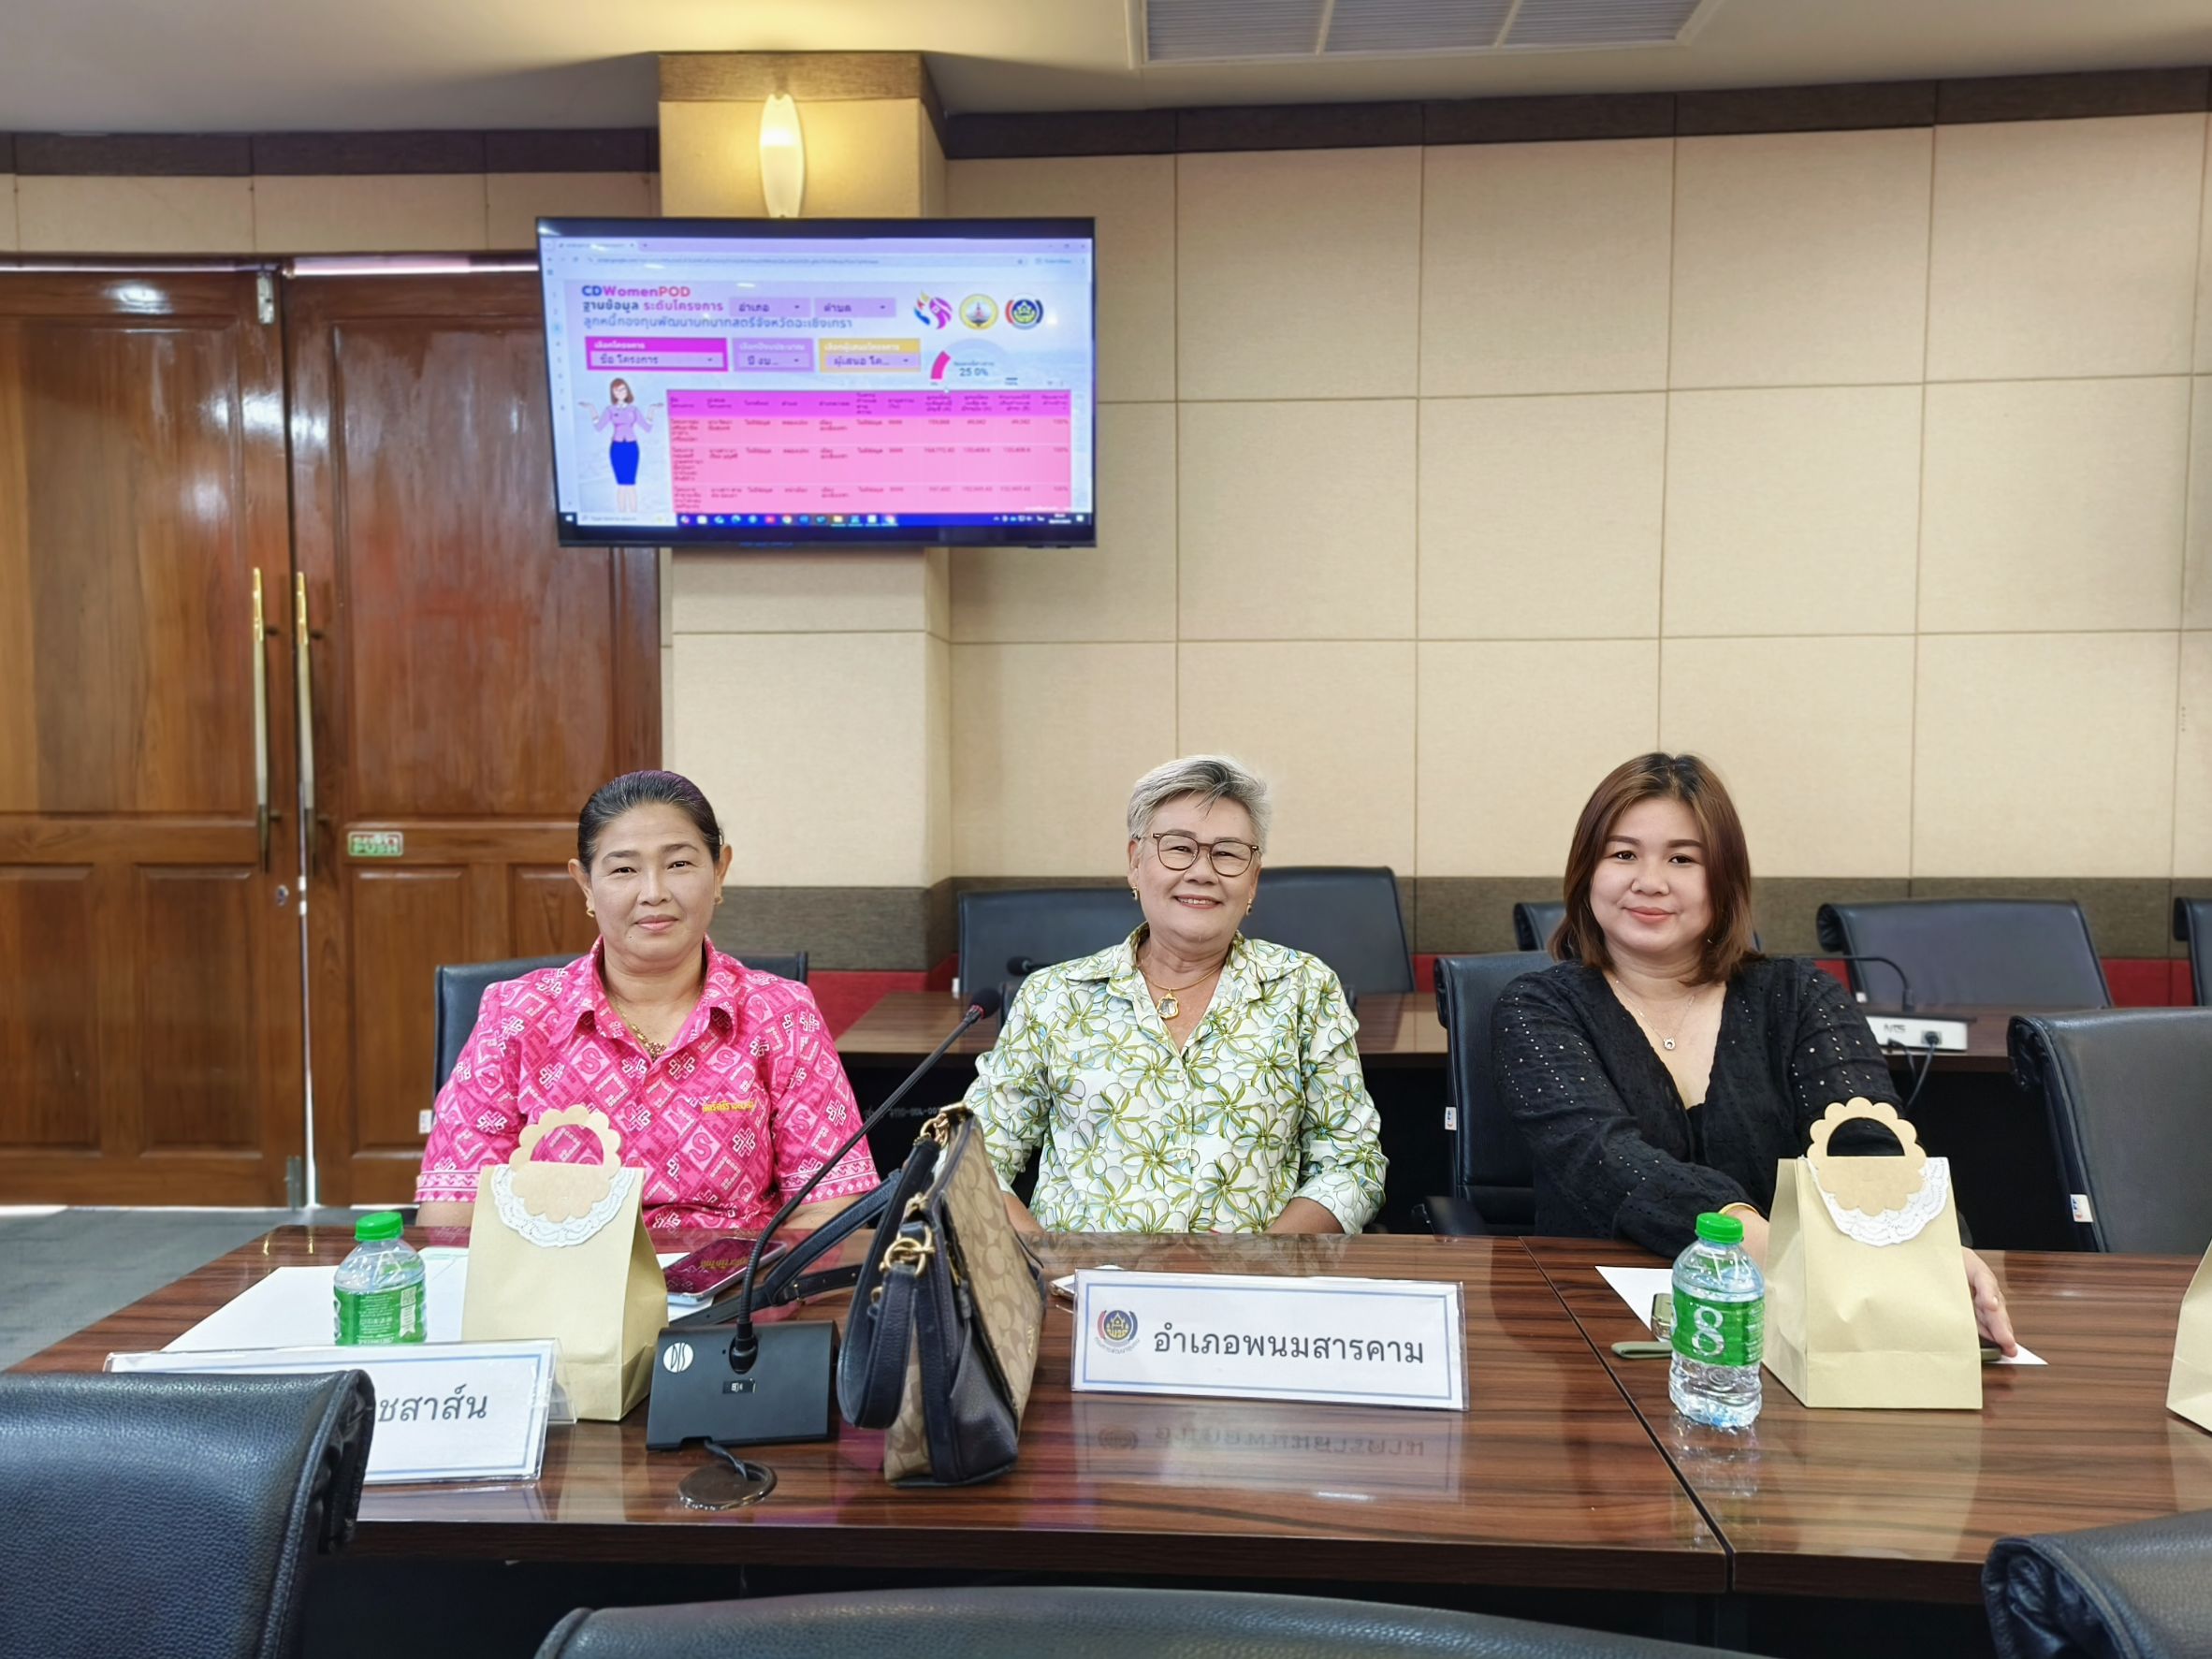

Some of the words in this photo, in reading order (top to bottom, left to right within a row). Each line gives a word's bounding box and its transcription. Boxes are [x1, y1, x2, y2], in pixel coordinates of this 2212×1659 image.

[581, 284, 691, 298] CDWomenPOD
[583, 298, 640, 313] ฐานข้อมูล
[643, 298, 724, 312] ระดับโครงการ
[738, 302, 770, 313] อำเภอ
[823, 302, 852, 313] ตำบล
[618, 354, 659, 364] โครงการ
[1691, 1306, 1724, 1356] 8
[1154, 1321, 1424, 1364] อำเภอพนมสารคาม
[377, 1384, 488, 1422] ชสาส์น
